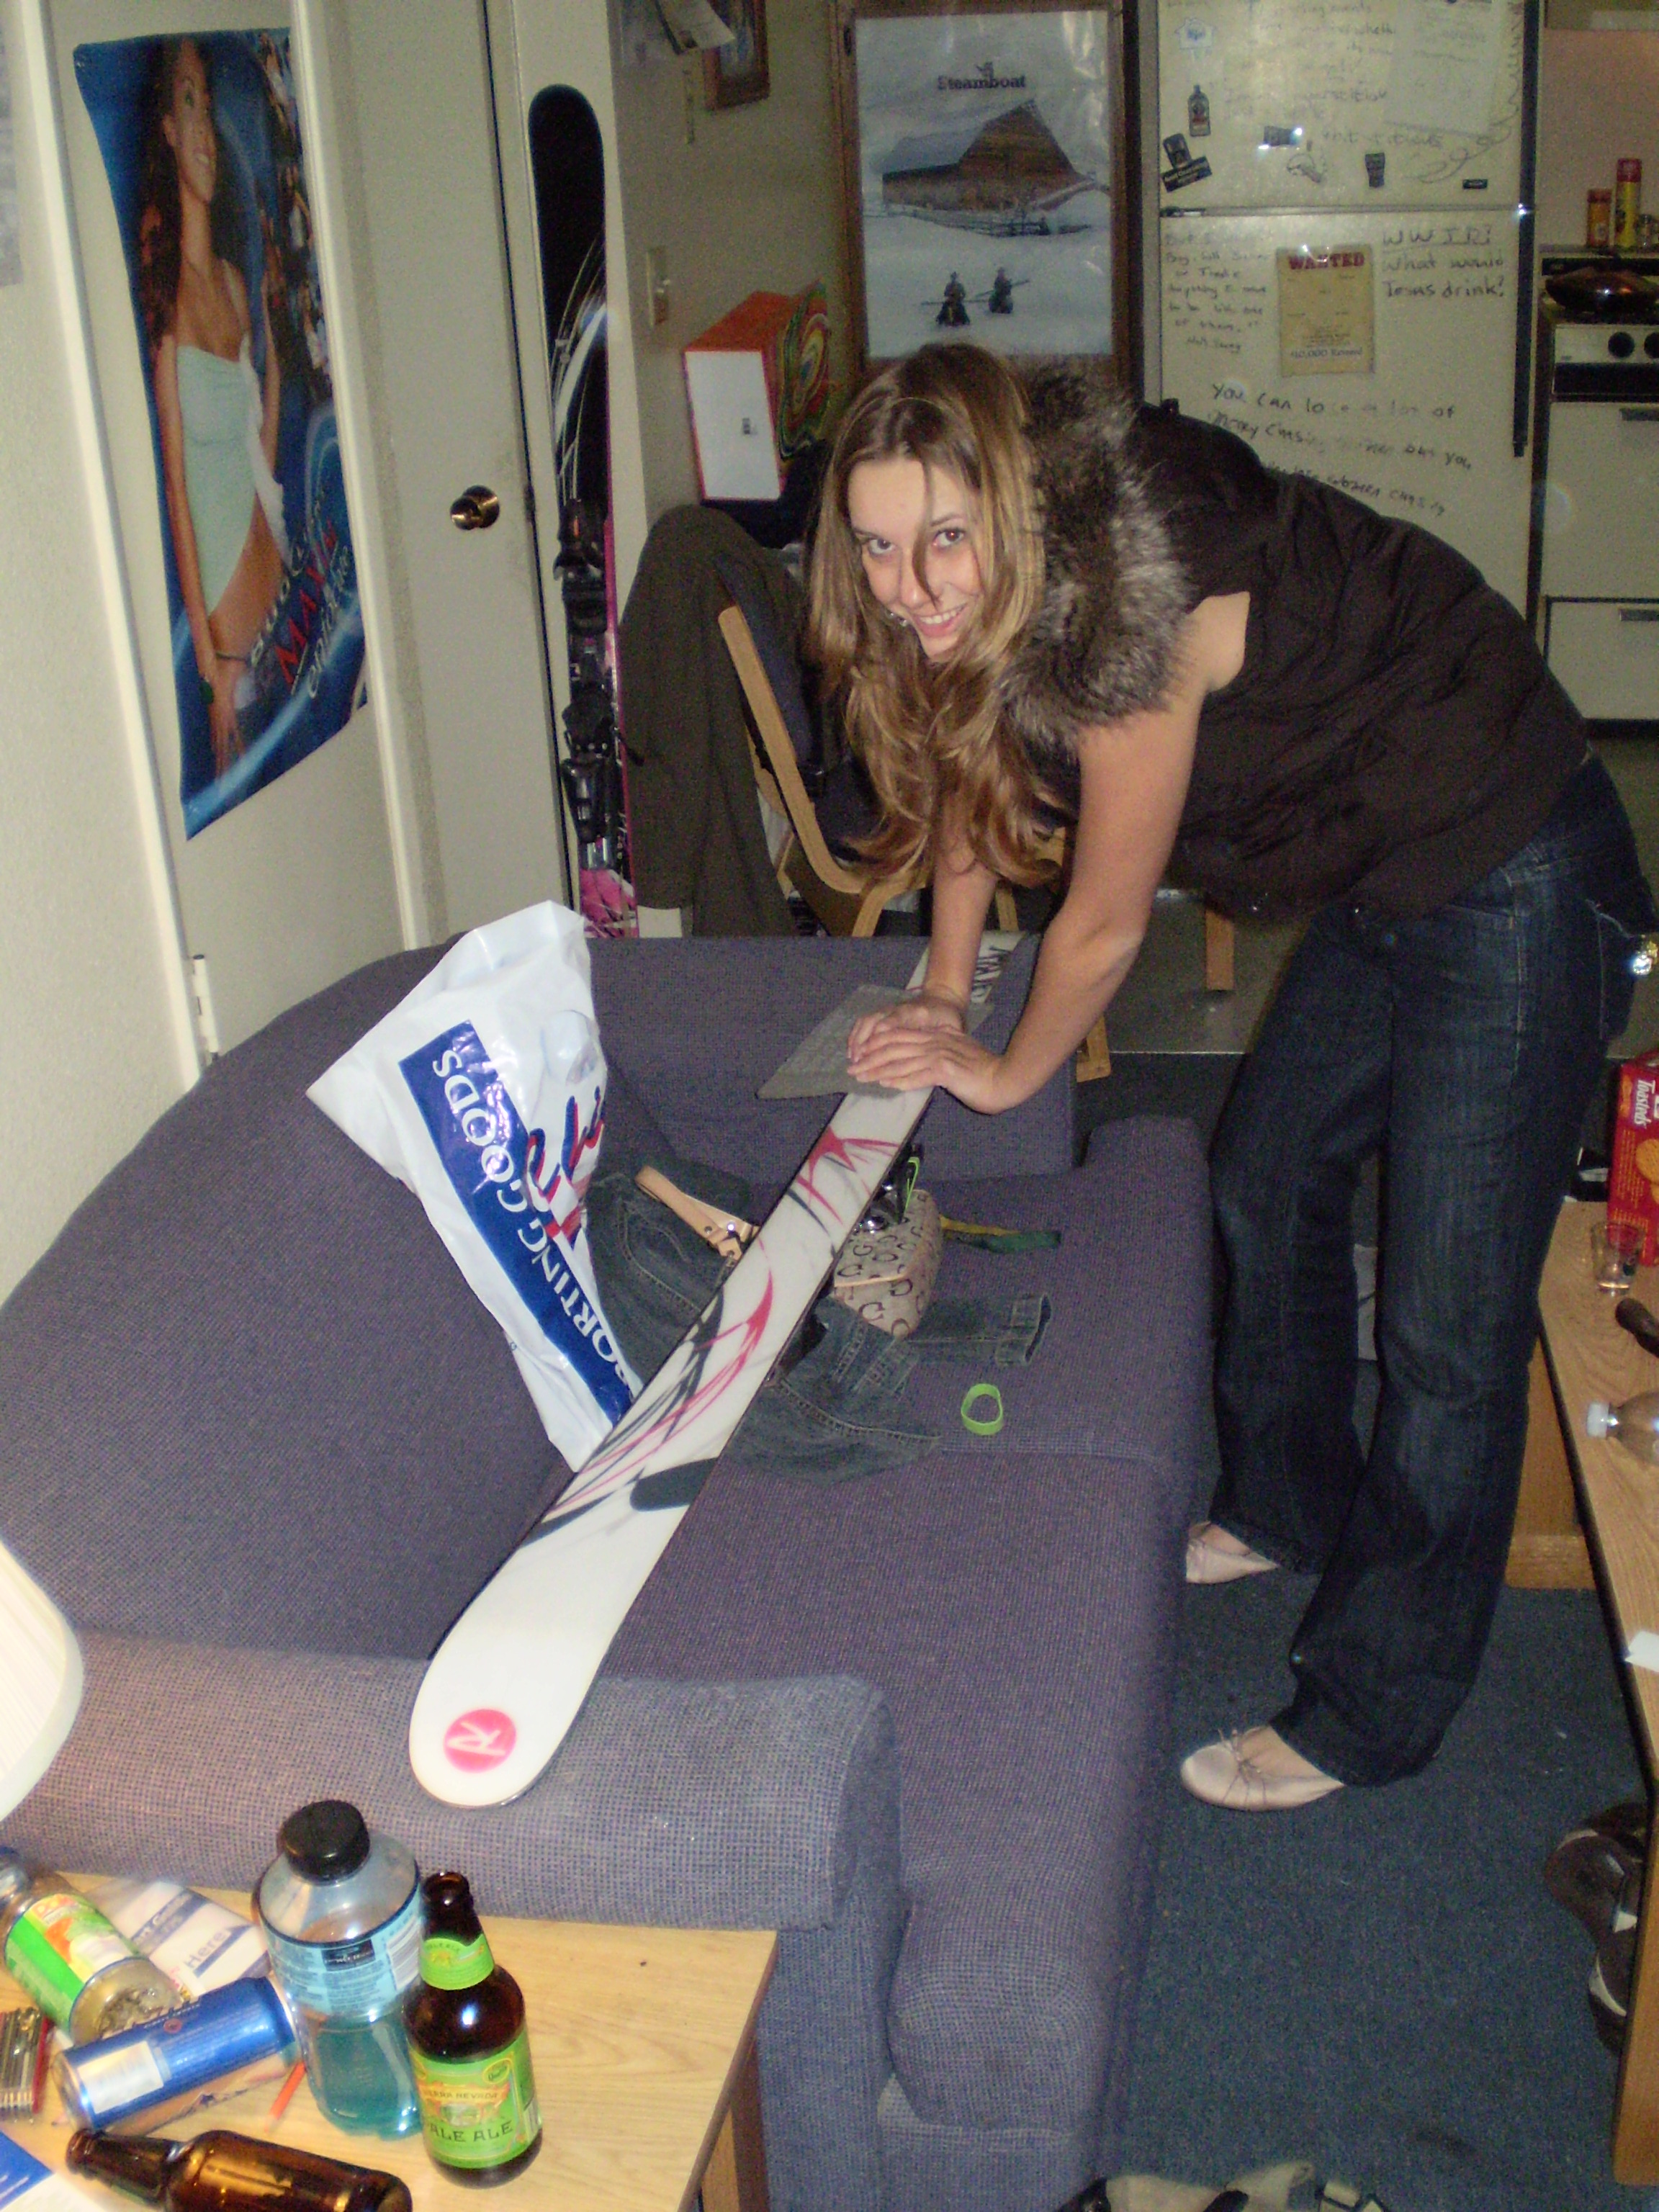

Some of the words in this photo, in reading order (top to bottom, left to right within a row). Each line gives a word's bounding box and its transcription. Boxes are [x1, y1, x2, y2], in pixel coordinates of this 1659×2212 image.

[938, 74, 1026, 90] Steamboat
[1288, 252, 1365, 270] WANTED
[1213, 383, 1246, 404] You
[1306, 397, 1350, 413] loe
[274, 517, 338, 685] MAXIM
[1633, 1079, 1655, 1128] Toasteds
[432, 1048, 529, 1214] GOODS
[517, 1216, 634, 1401] ORTING
[183, 1929, 226, 1969] Here
[426, 2121, 466, 2142] ALE
[473, 2119, 513, 2142] ALE
